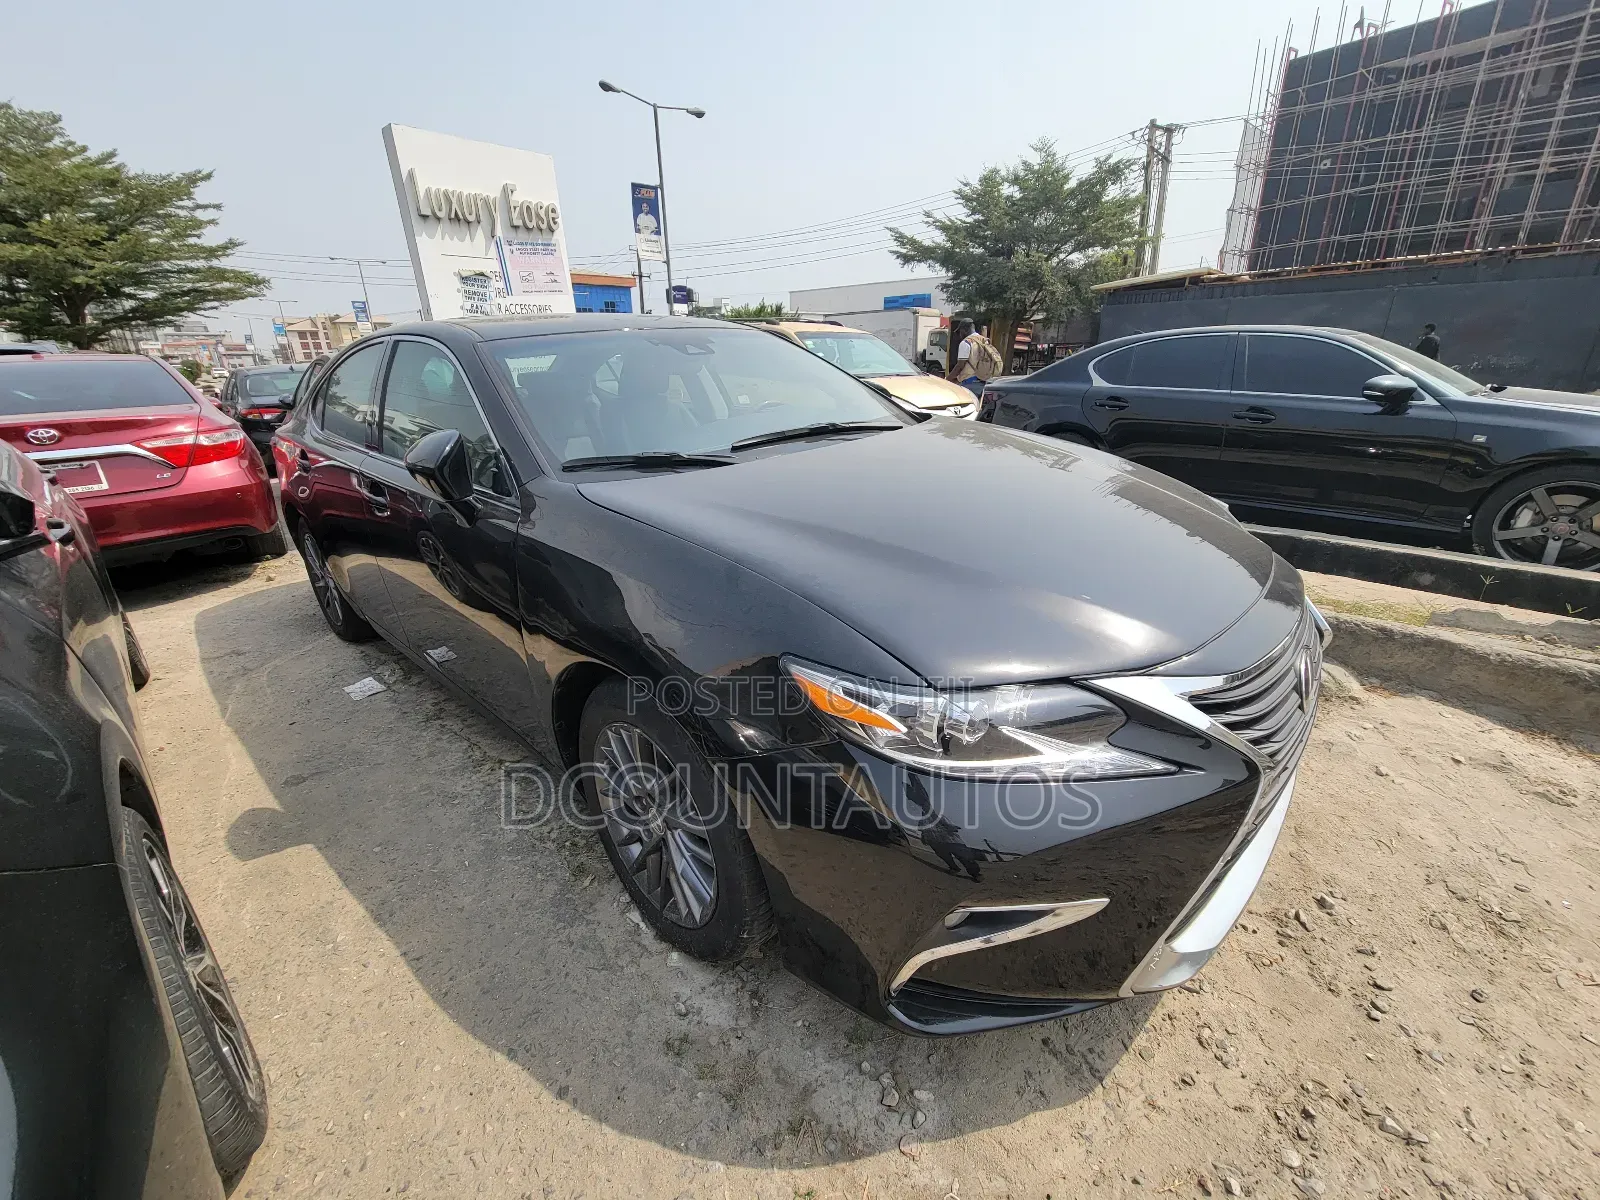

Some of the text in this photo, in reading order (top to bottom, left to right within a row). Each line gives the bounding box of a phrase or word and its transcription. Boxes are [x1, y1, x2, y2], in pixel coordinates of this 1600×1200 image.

[408, 167, 560, 238] Luxury Ease
[517, 256, 556, 264] WARNING
[461, 276, 487, 284] REGISTER
[464, 289, 487, 297] REMOVE
[504, 303, 552, 315] ACCESSORIES
